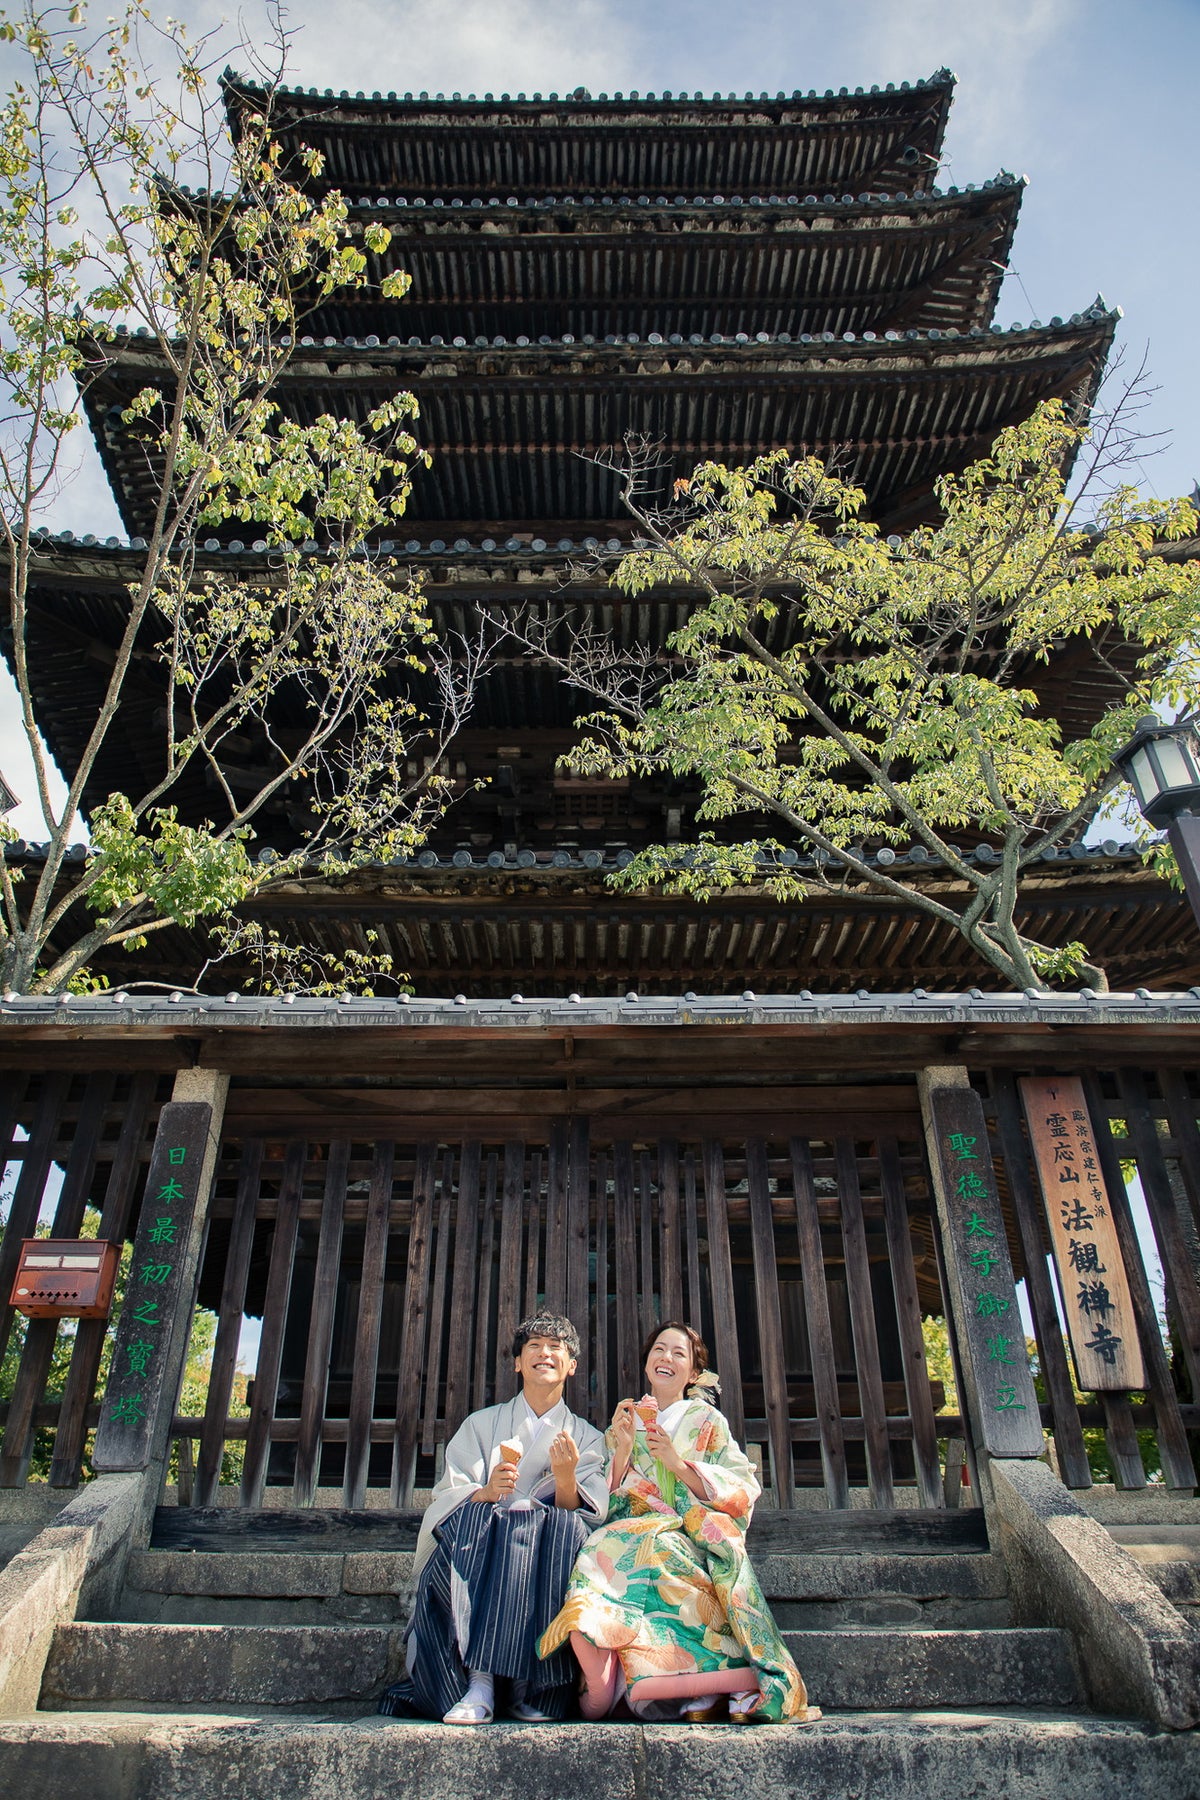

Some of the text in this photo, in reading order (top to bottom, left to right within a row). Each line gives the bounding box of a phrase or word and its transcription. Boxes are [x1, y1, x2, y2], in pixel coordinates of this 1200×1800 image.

[110, 1146, 187, 1425] 日本最初之寶塔
[948, 1133, 1026, 1413] 聖徳太子御建立
